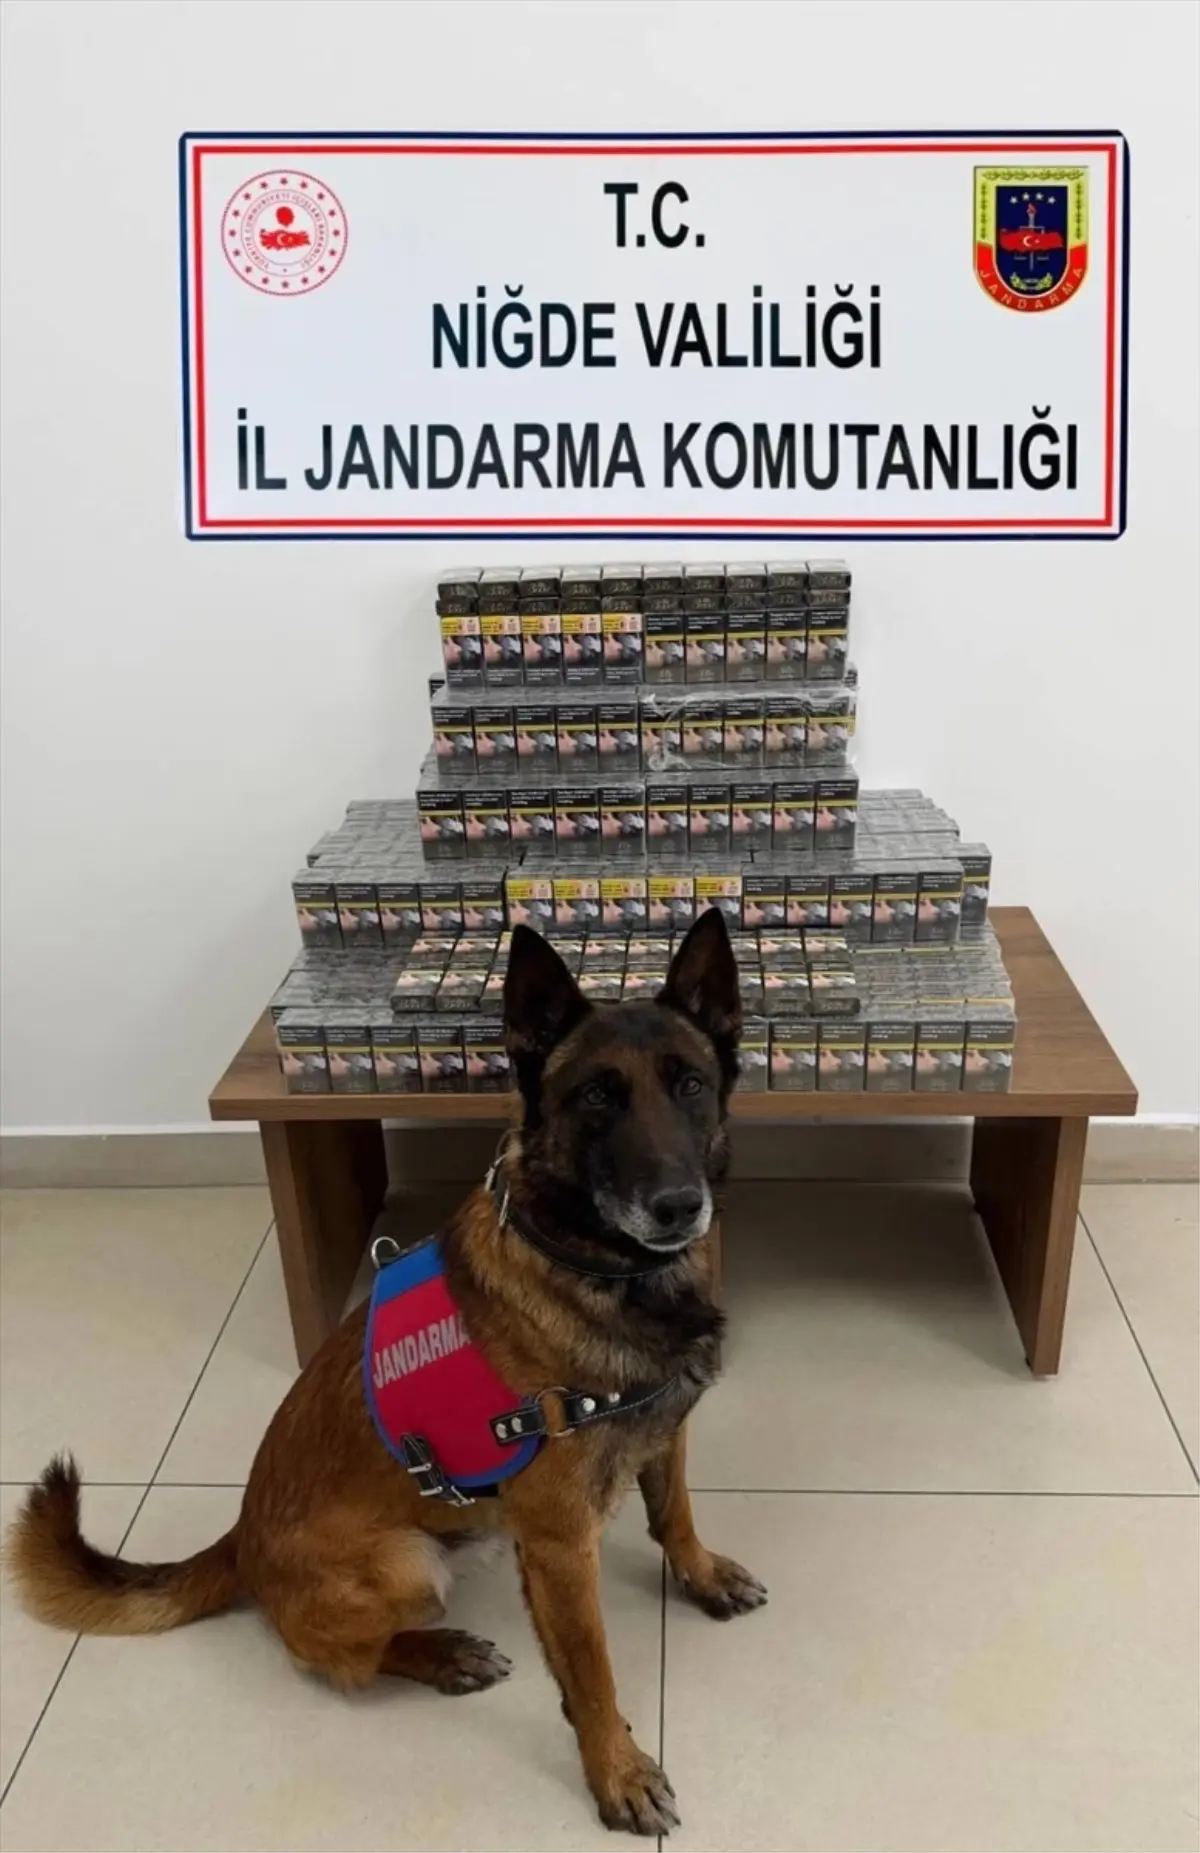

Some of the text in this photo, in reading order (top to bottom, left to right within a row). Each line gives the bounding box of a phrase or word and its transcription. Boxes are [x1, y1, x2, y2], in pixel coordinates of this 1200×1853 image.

[604, 182, 705, 249] T.C.
[432, 283, 881, 369] NİĞDE VALİLİĞİ
[978, 268, 1084, 311] JANDARMA
[237, 405, 1078, 491] İL JANDARMA KOMUTANLIĞI
[373, 1312, 472, 1389] JANDARMA
